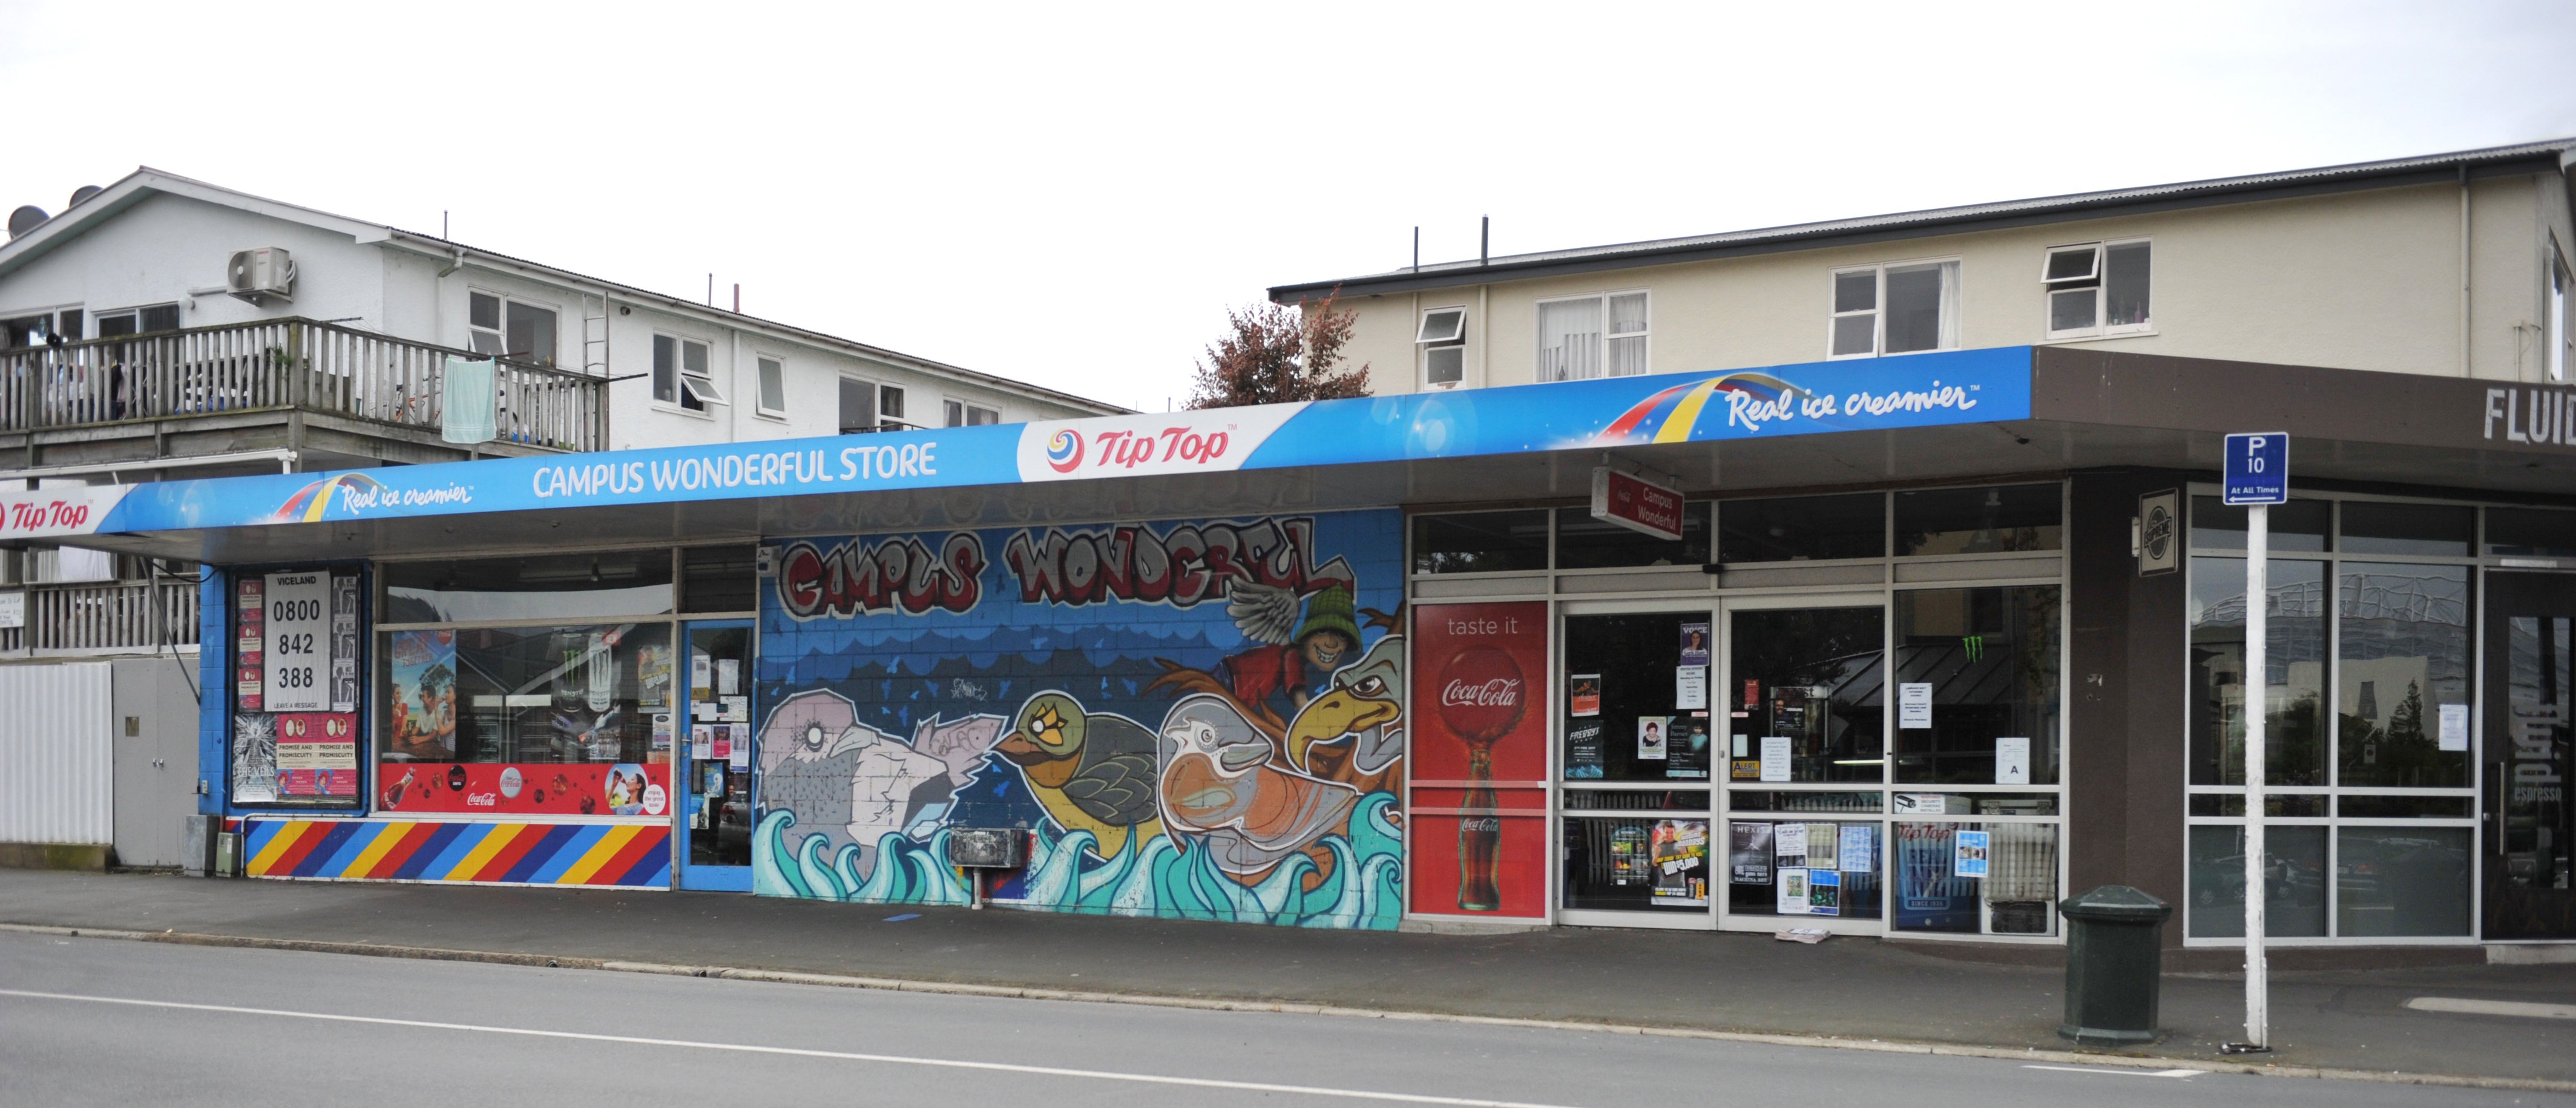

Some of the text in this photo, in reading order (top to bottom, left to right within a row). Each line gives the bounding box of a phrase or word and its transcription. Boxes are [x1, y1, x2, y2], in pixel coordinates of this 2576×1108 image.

[1724, 389, 1793, 432] Real
[1801, 389, 1837, 419] ice
[1844, 380, 1977, 416] creamier
[1096, 430, 1155, 468] Tip
[1160, 426, 1229, 464] Top
[2249, 437, 2266, 457] P
[533, 442, 938, 498] CAMPUS WONDERFUL STORE
[2248, 457, 2264, 473] 10
[342, 484, 378, 515] Real
[381, 486, 400, 507] ice
[404, 482, 472, 506] creamier
[1643, 487, 1672, 509] Campus
[12, 502, 46, 532] Tip
[49, 500, 88, 529] Top
[1638, 505, 1676, 531] Wonderful
[277, 576, 317, 585] VICELAND
[779, 532, 987, 619] CAMPUS
[274, 599, 320, 622] 0800
[1448, 616, 1518, 635] taste it
[279, 633, 313, 655] 842
[278, 667, 313, 688] 388
[1442, 679, 1520, 706] Coca-Cola
[238, 767, 253, 777] THE
[2010, 765, 2019, 774] A
[467, 793, 496, 806] Coca-Cola
[2514, 786, 2561, 803] espresso
